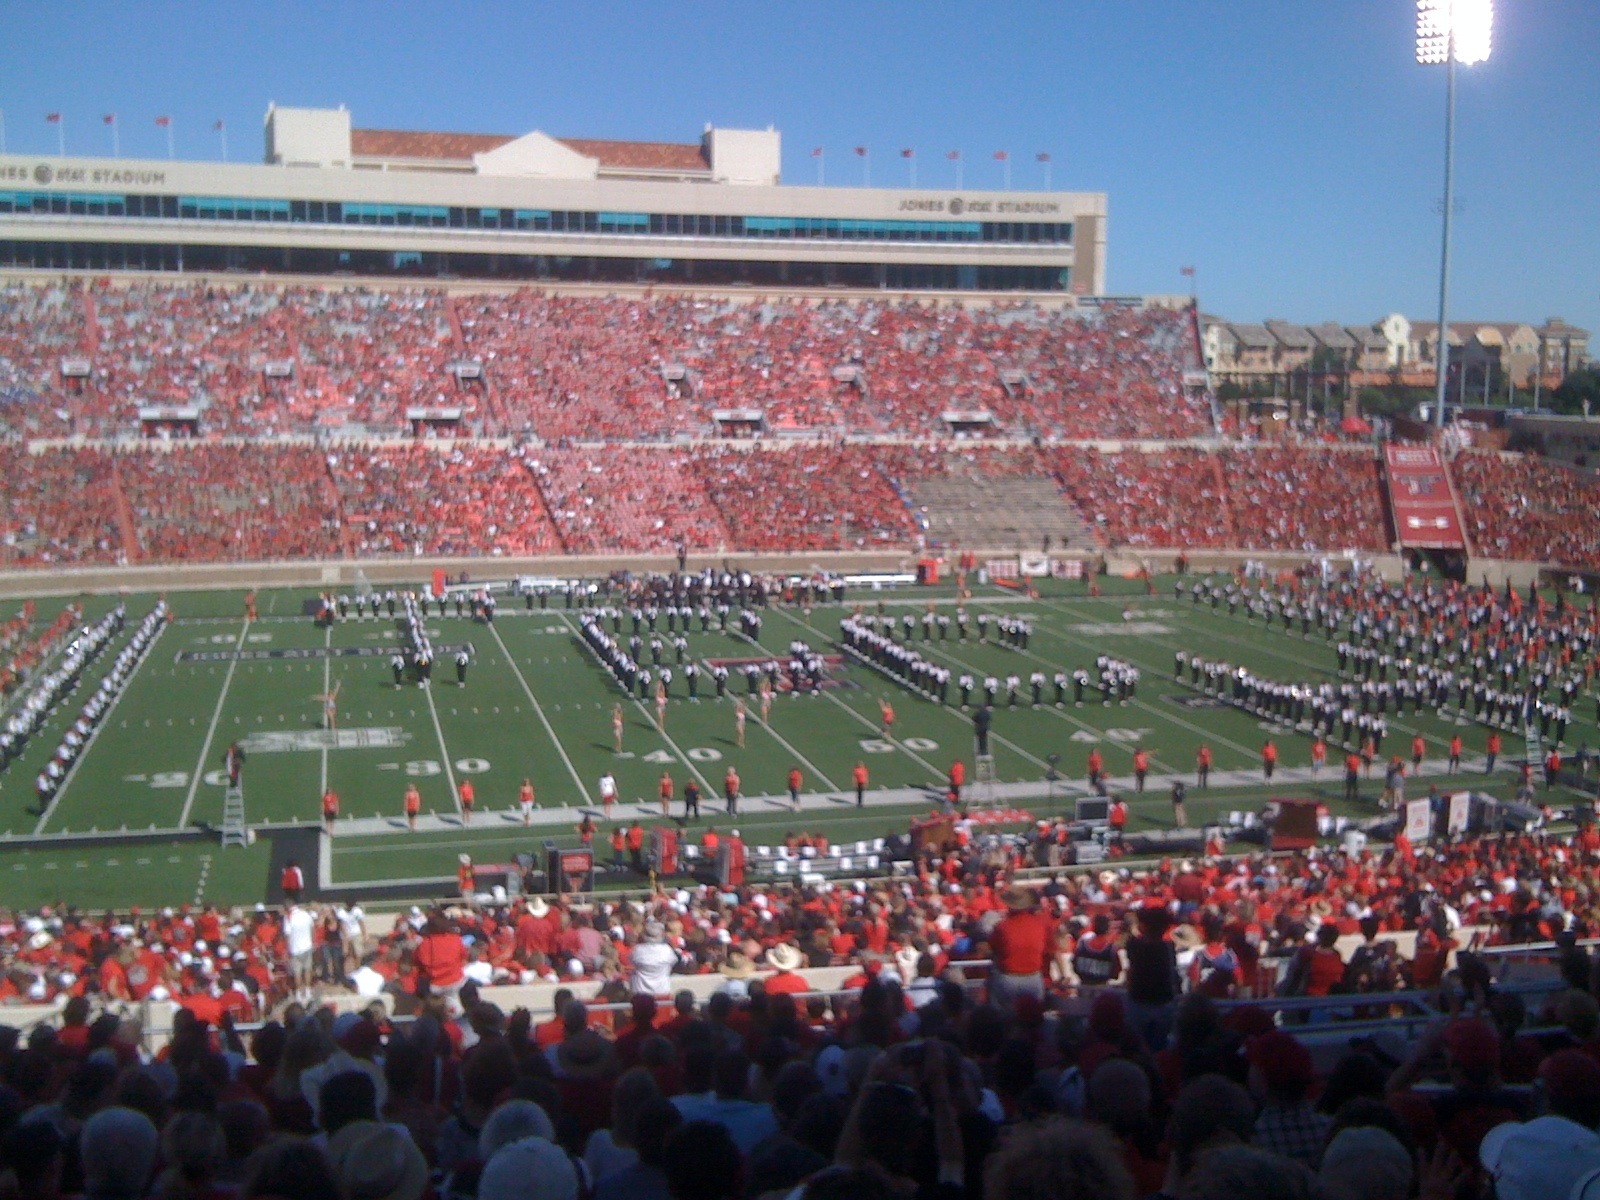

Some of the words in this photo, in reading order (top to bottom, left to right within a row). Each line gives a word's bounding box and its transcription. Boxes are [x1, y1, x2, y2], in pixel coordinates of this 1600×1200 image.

[93, 169, 165, 185] STADIUM
[899, 199, 944, 212] JONES
[996, 202, 1060, 215] STADIUM
